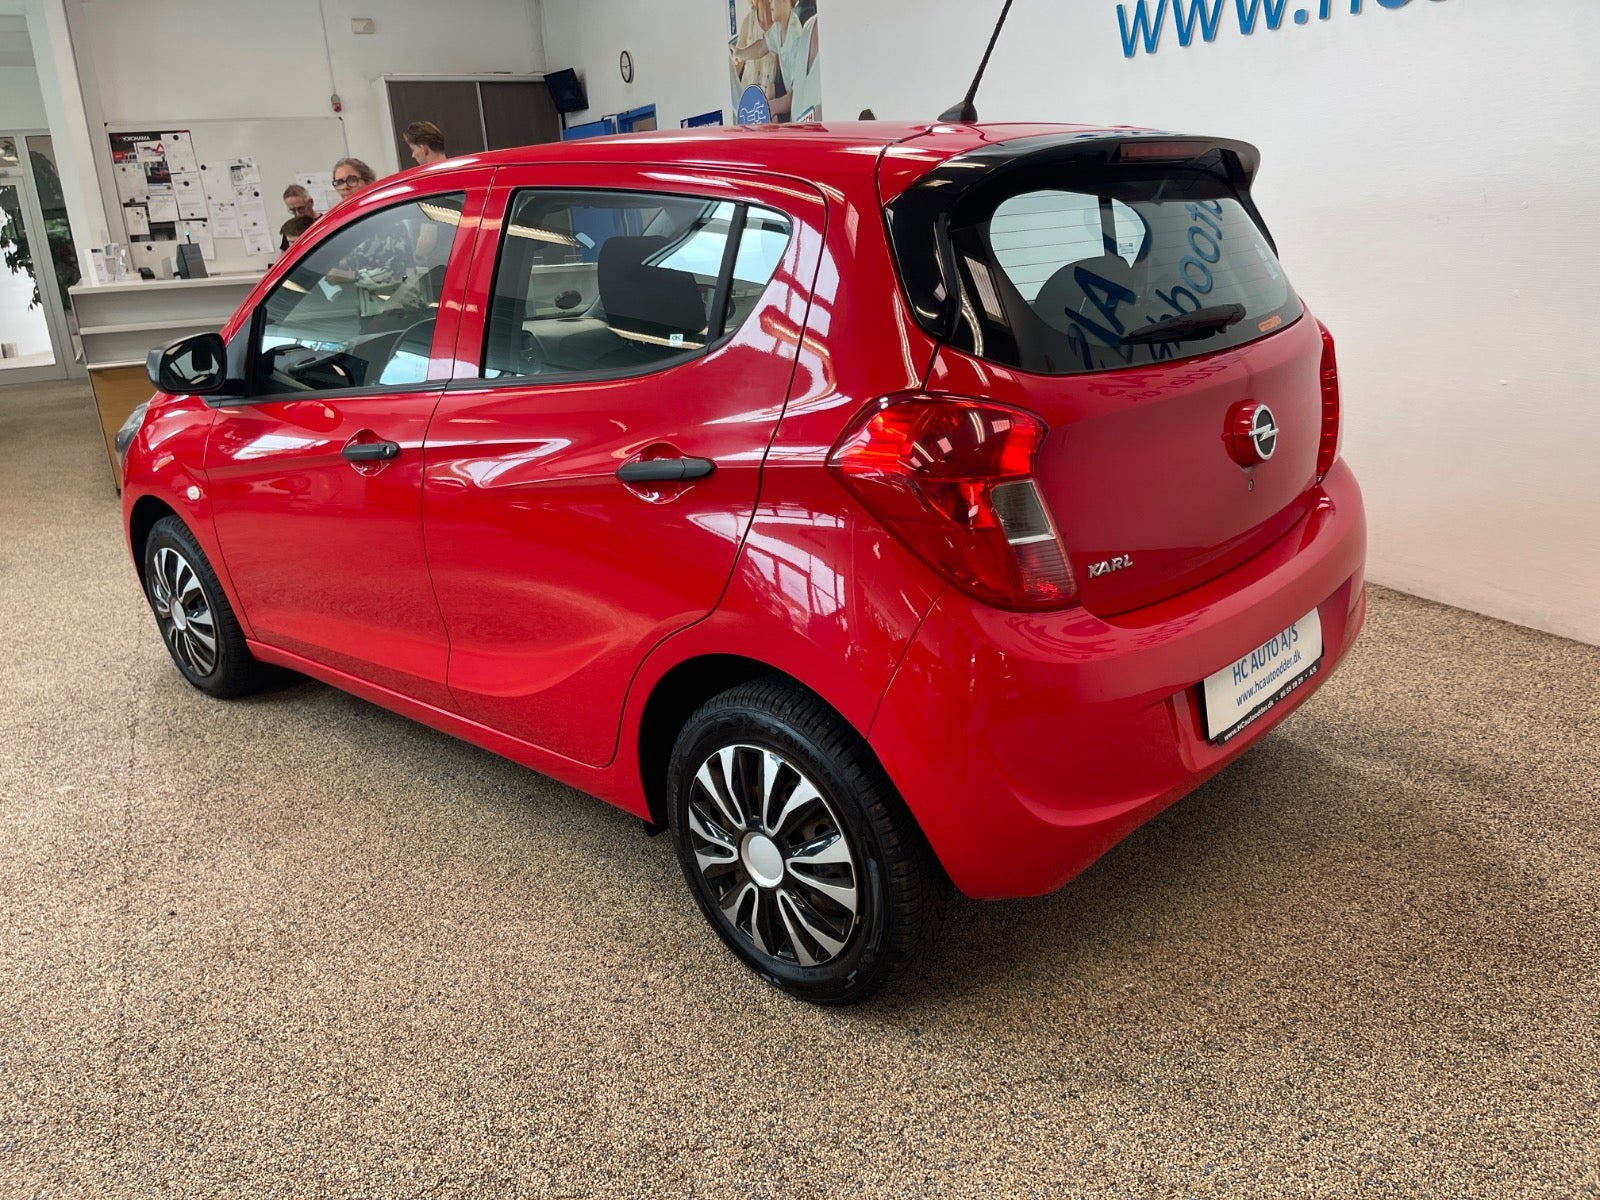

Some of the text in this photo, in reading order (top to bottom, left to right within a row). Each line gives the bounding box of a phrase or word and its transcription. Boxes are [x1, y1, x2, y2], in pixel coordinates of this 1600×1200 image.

[1088, 554, 1133, 578] KARL
[1233, 624, 1298, 686] HC AUTO A/S
[1236, 649, 1302, 707] www.hcautoodder.dk
